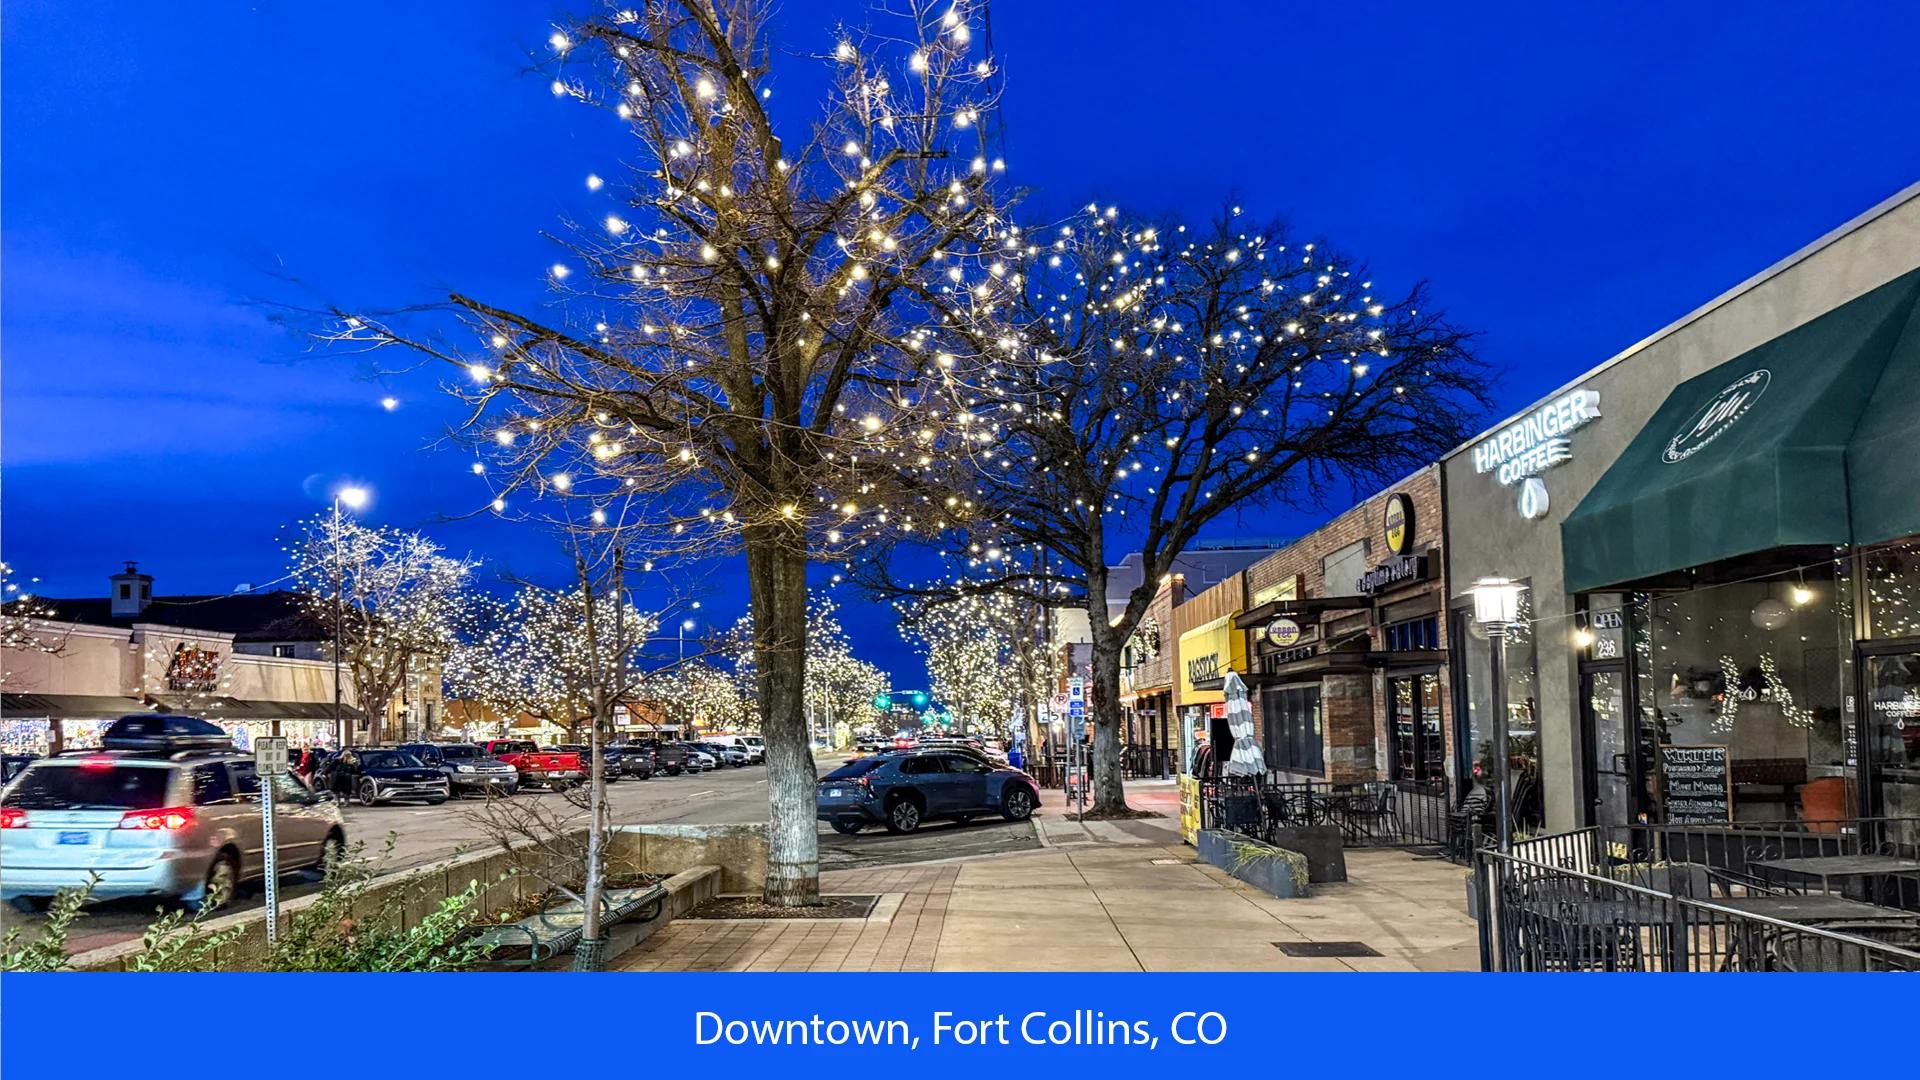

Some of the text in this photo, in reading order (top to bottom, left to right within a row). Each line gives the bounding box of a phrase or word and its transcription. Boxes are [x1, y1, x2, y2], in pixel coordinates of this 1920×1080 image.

[1474, 389, 1601, 474] HARBINGER
[1499, 438, 1573, 485] COFFEE
[1593, 612, 1623, 629] OPEN
[1597, 639, 1616, 658] 236
[1188, 653, 1219, 684] RAGSTOCK
[1662, 748, 1726, 763] WINTER
